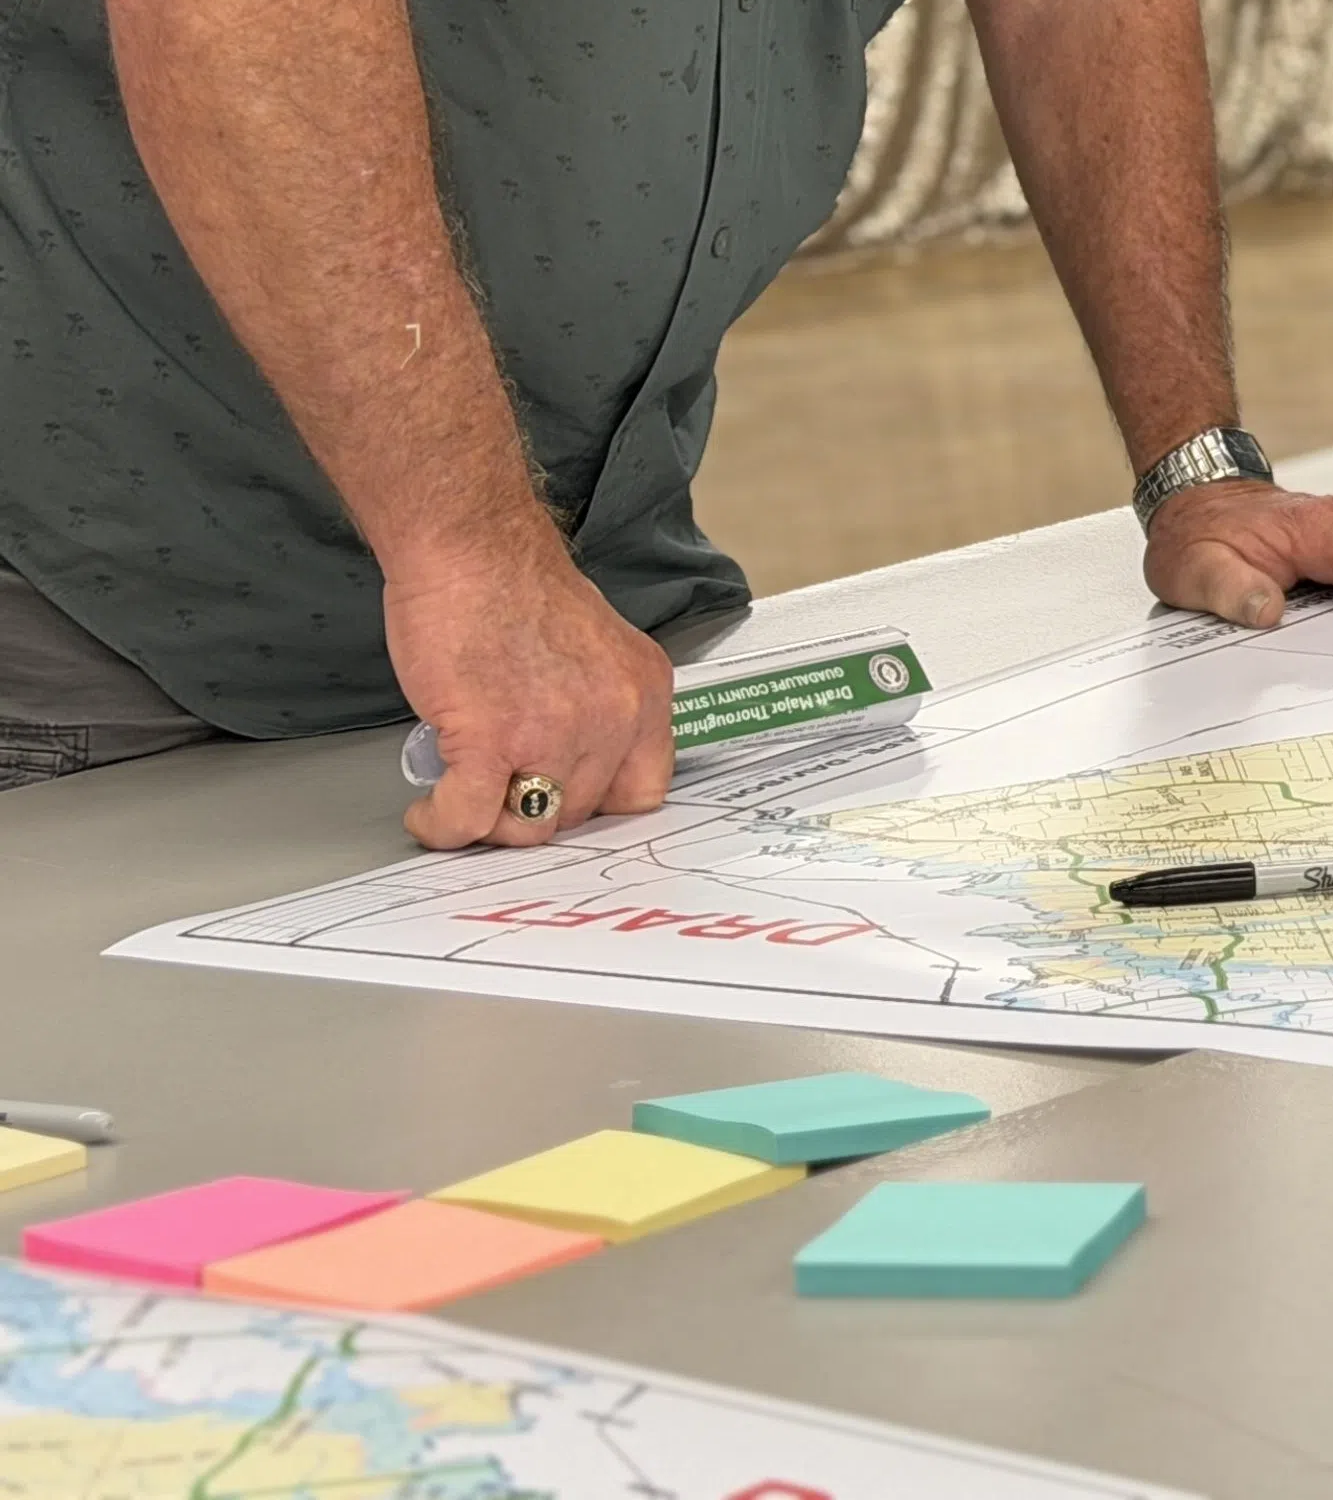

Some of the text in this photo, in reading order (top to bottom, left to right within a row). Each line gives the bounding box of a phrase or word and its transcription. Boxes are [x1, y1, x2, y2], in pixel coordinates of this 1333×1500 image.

[769, 666, 845, 693] GUADALUPE
[671, 695, 711, 715] STATE
[717, 683, 769, 706] COUNTY
[771, 693, 815, 715] Major
[814, 685, 854, 707] Draft
[449, 900, 878, 947] DRAFT
